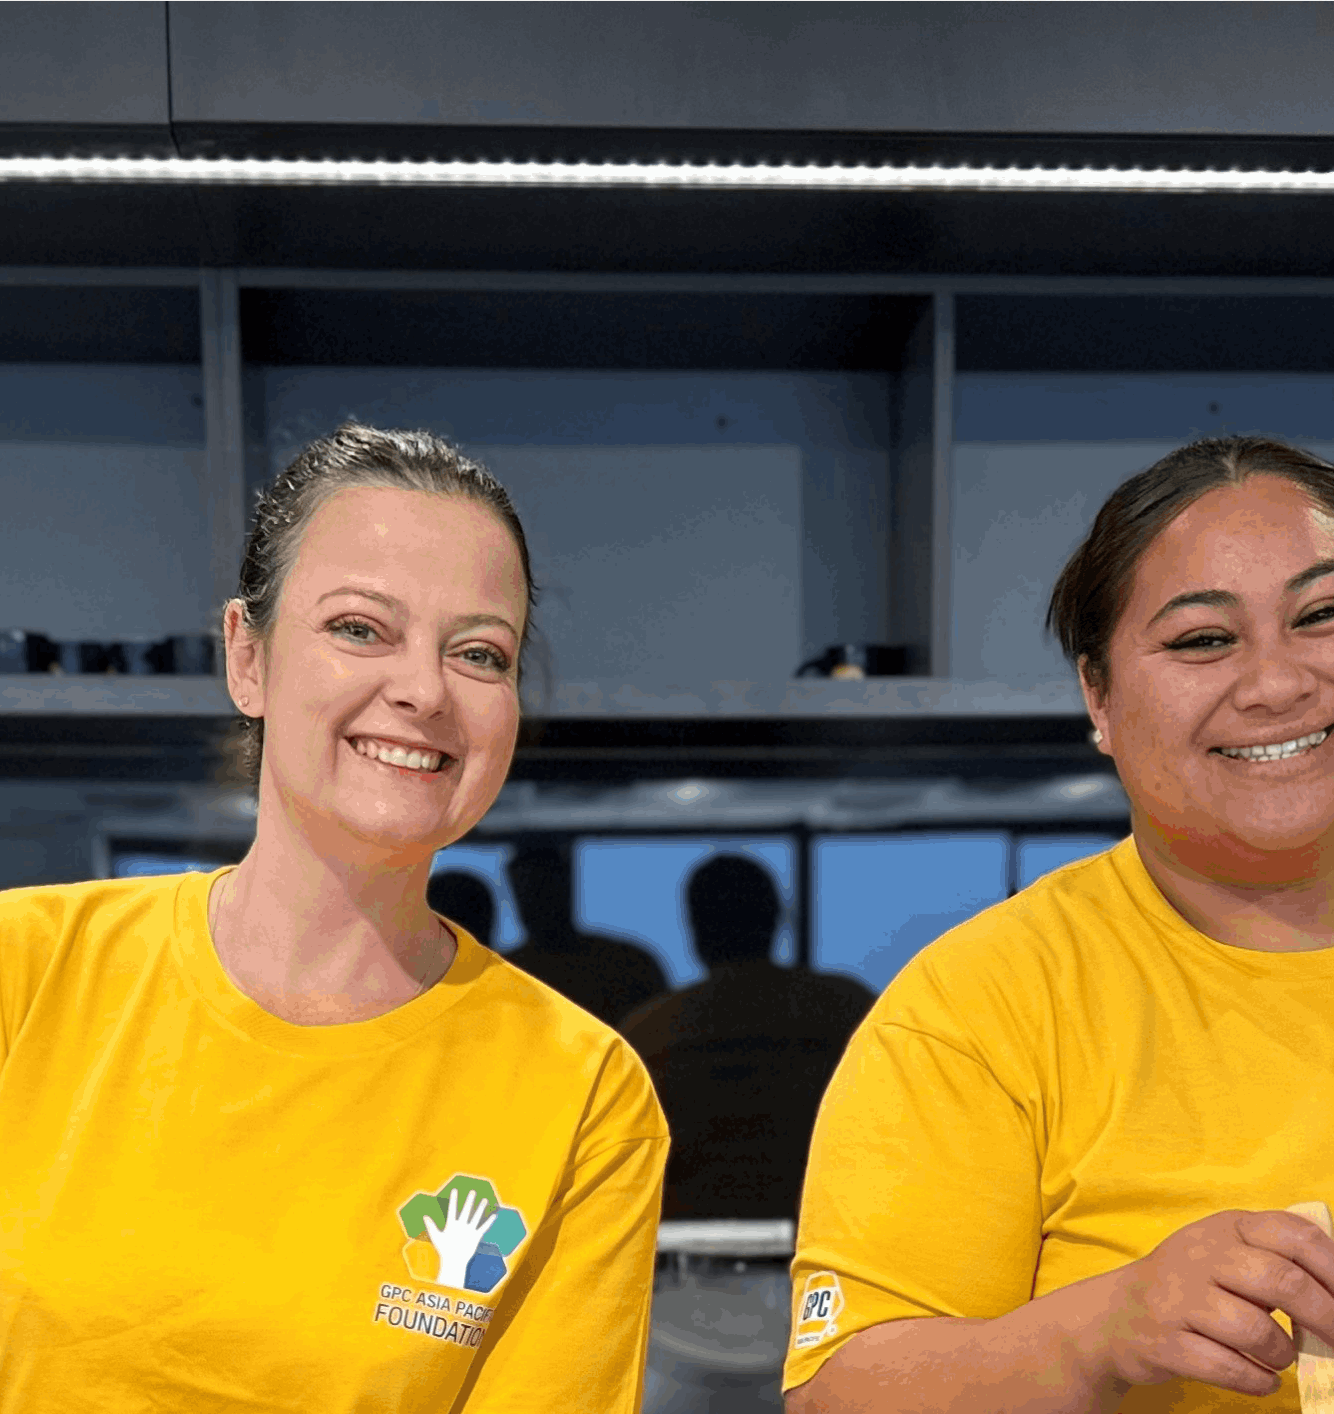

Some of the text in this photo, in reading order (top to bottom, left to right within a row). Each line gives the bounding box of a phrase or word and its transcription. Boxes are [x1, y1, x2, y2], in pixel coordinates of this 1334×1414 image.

[381, 1284, 494, 1323] GPC ASIA PACIF
